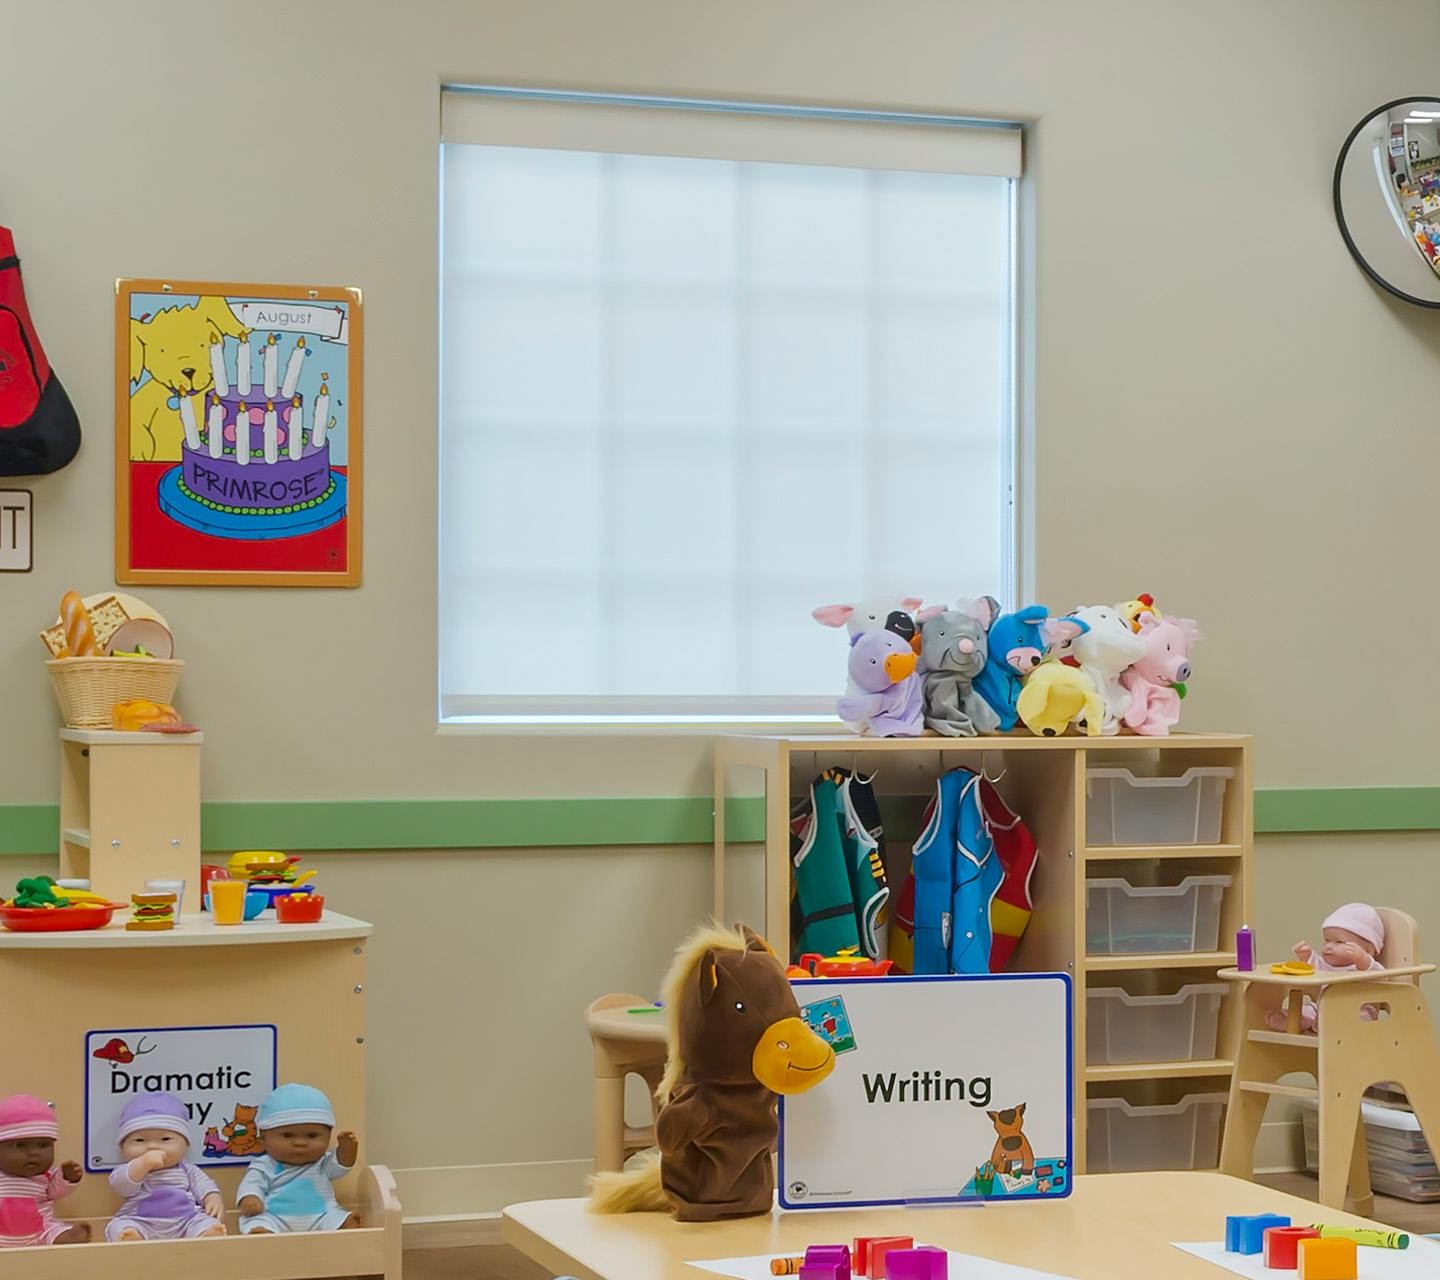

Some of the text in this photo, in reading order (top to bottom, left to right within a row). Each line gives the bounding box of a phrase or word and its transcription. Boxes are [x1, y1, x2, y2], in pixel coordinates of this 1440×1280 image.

[256, 309, 313, 327] August
[111, 1065, 252, 1094] Dramatic
[862, 1069, 994, 1108] Writing
